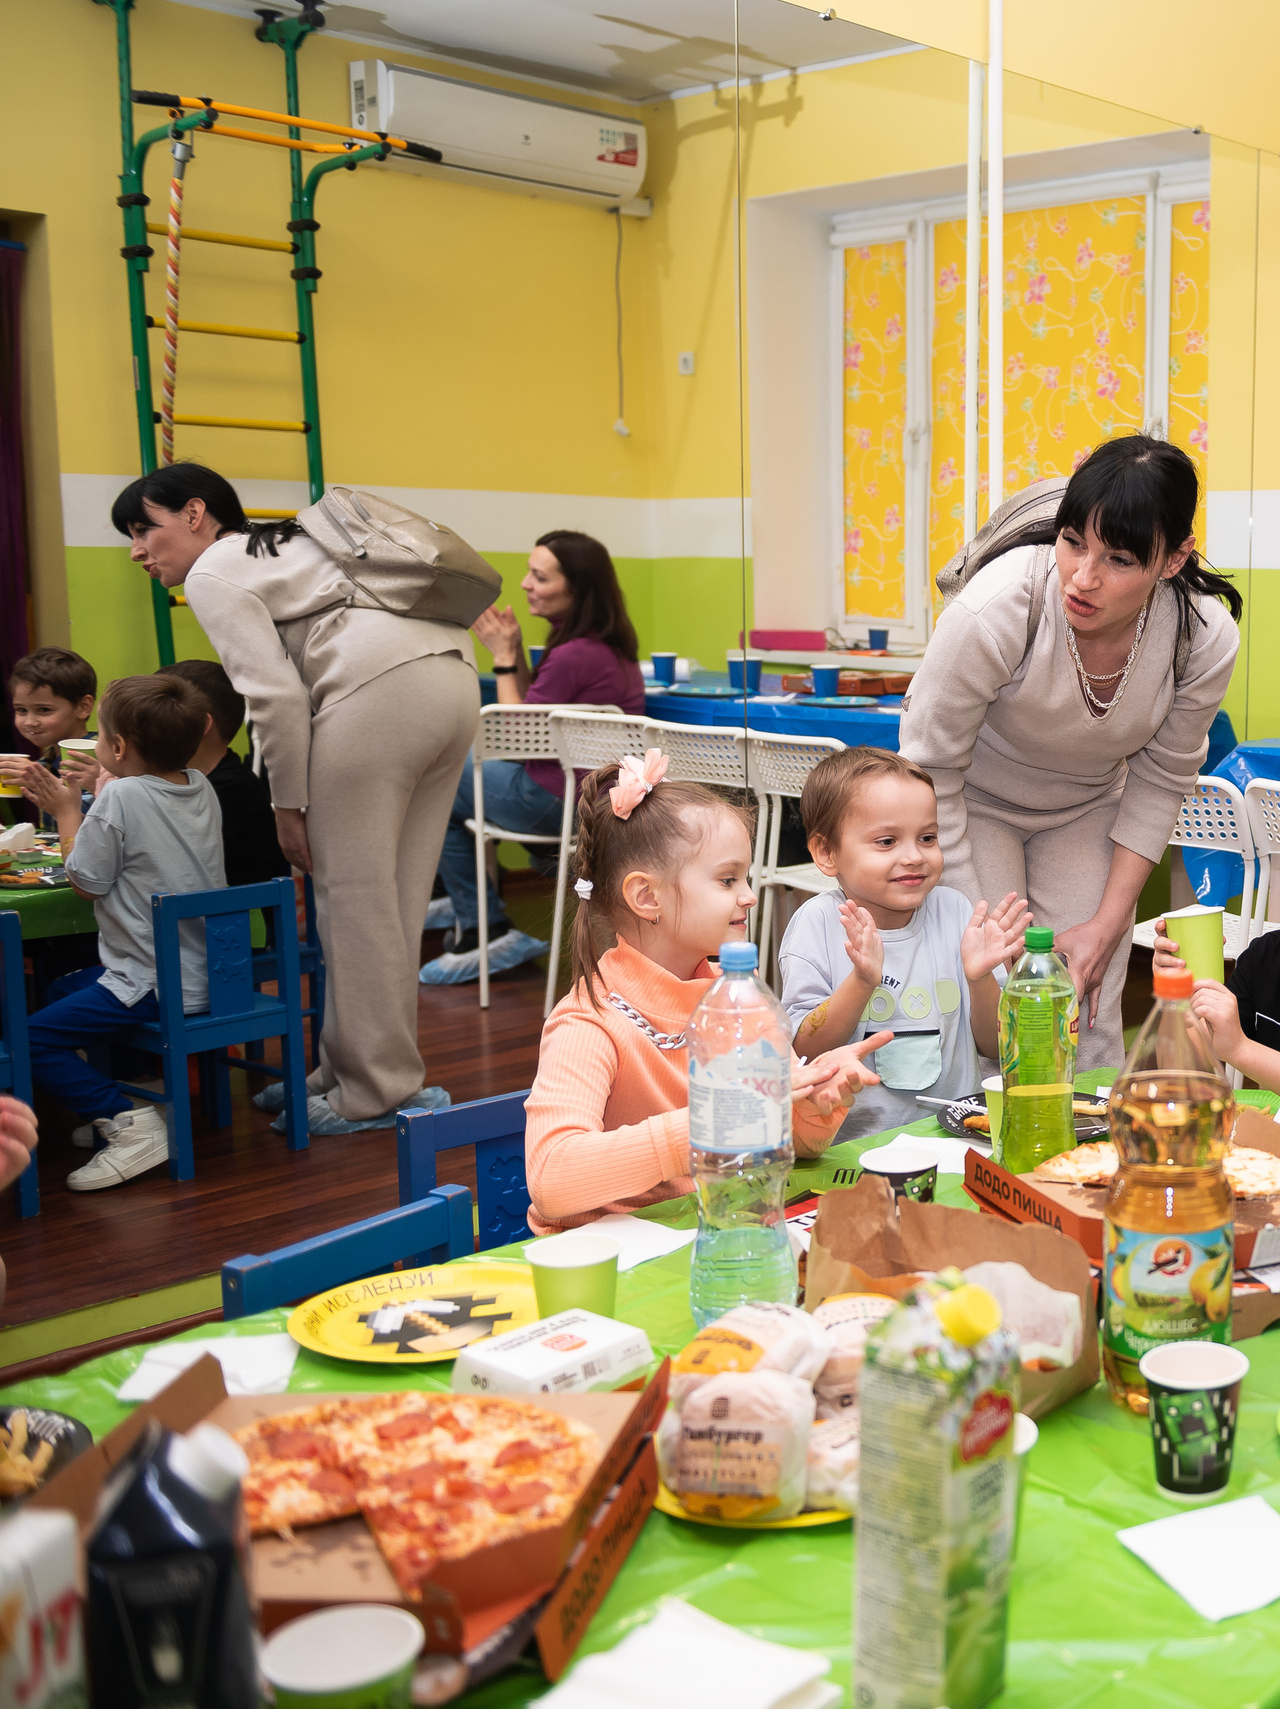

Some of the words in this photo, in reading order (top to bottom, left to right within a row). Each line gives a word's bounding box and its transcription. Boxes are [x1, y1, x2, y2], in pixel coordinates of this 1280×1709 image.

[974, 1162, 1011, 1201] ДОДО
[1013, 1187, 1064, 1233] ПИЦЦА
[327, 1268, 434, 1313] ИССЛЕДУЙ
[682, 1425, 764, 1446] Гамбургер
